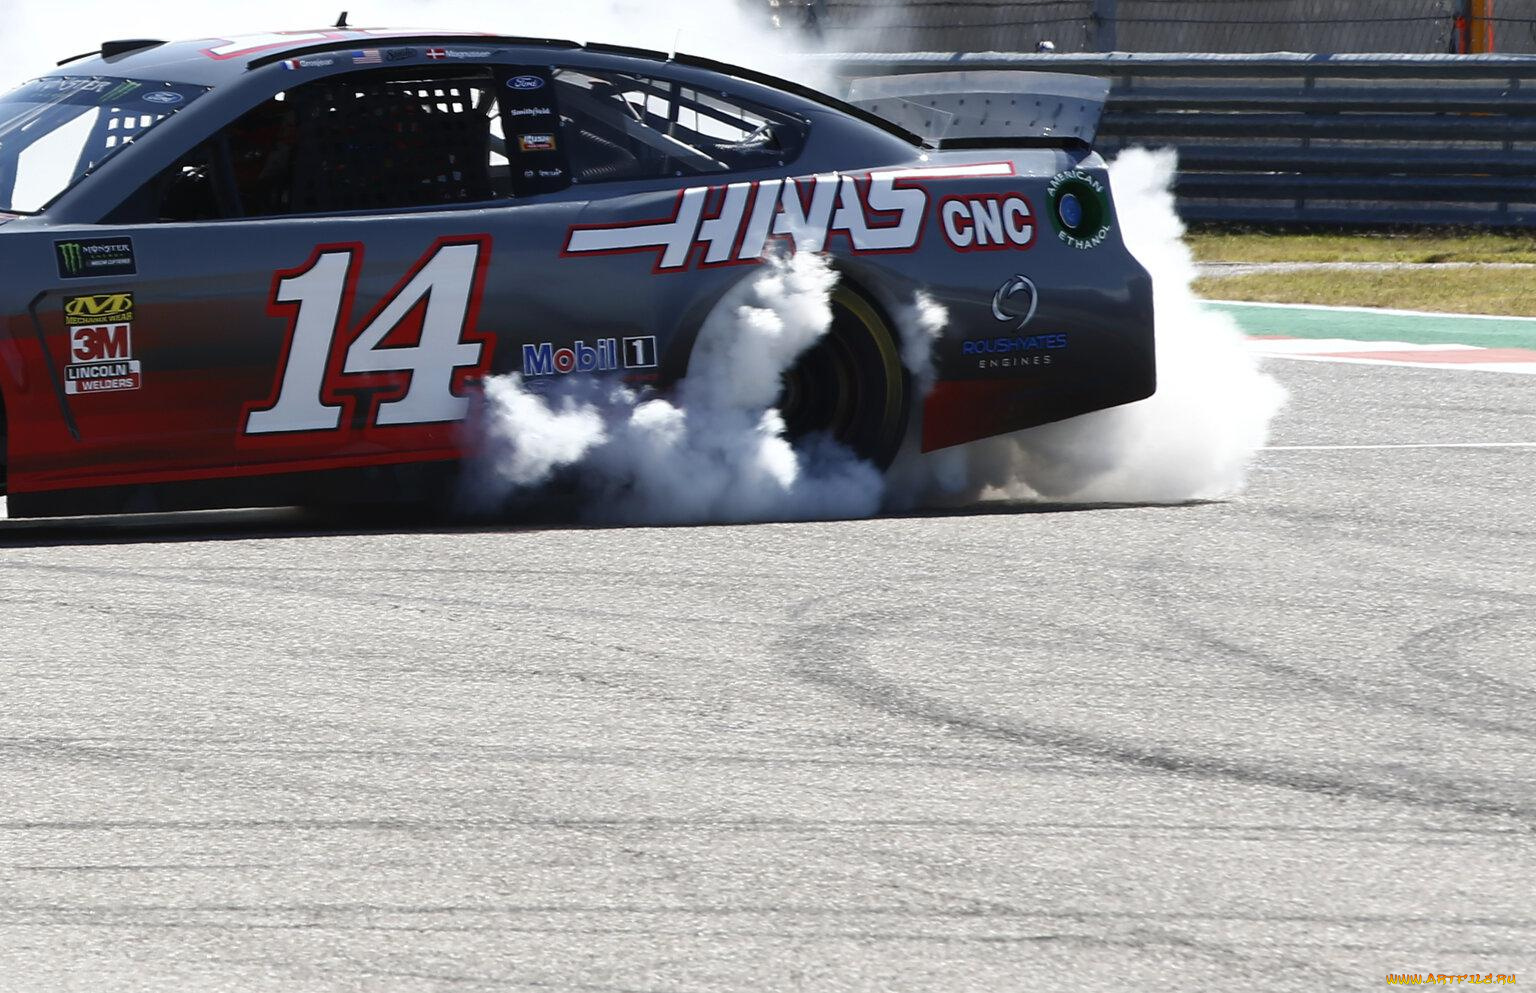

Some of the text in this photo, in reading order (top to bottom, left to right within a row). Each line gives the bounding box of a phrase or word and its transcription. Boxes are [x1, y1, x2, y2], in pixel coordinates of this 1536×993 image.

[512, 76, 540, 88] Ford
[1046, 170, 1104, 197] AMERICAN
[564, 163, 1035, 270] HAAS CNC
[82, 244, 131, 254] MONSTER
[1058, 223, 1112, 250] ETHANOL
[73, 326, 128, 361] 3M
[242, 239, 488, 436] 14
[522, 338, 618, 376] Mobil
[978, 355, 1052, 368] ENGINES
[68, 363, 127, 379] LINCOLN
[82, 378, 134, 390] WELDERS
